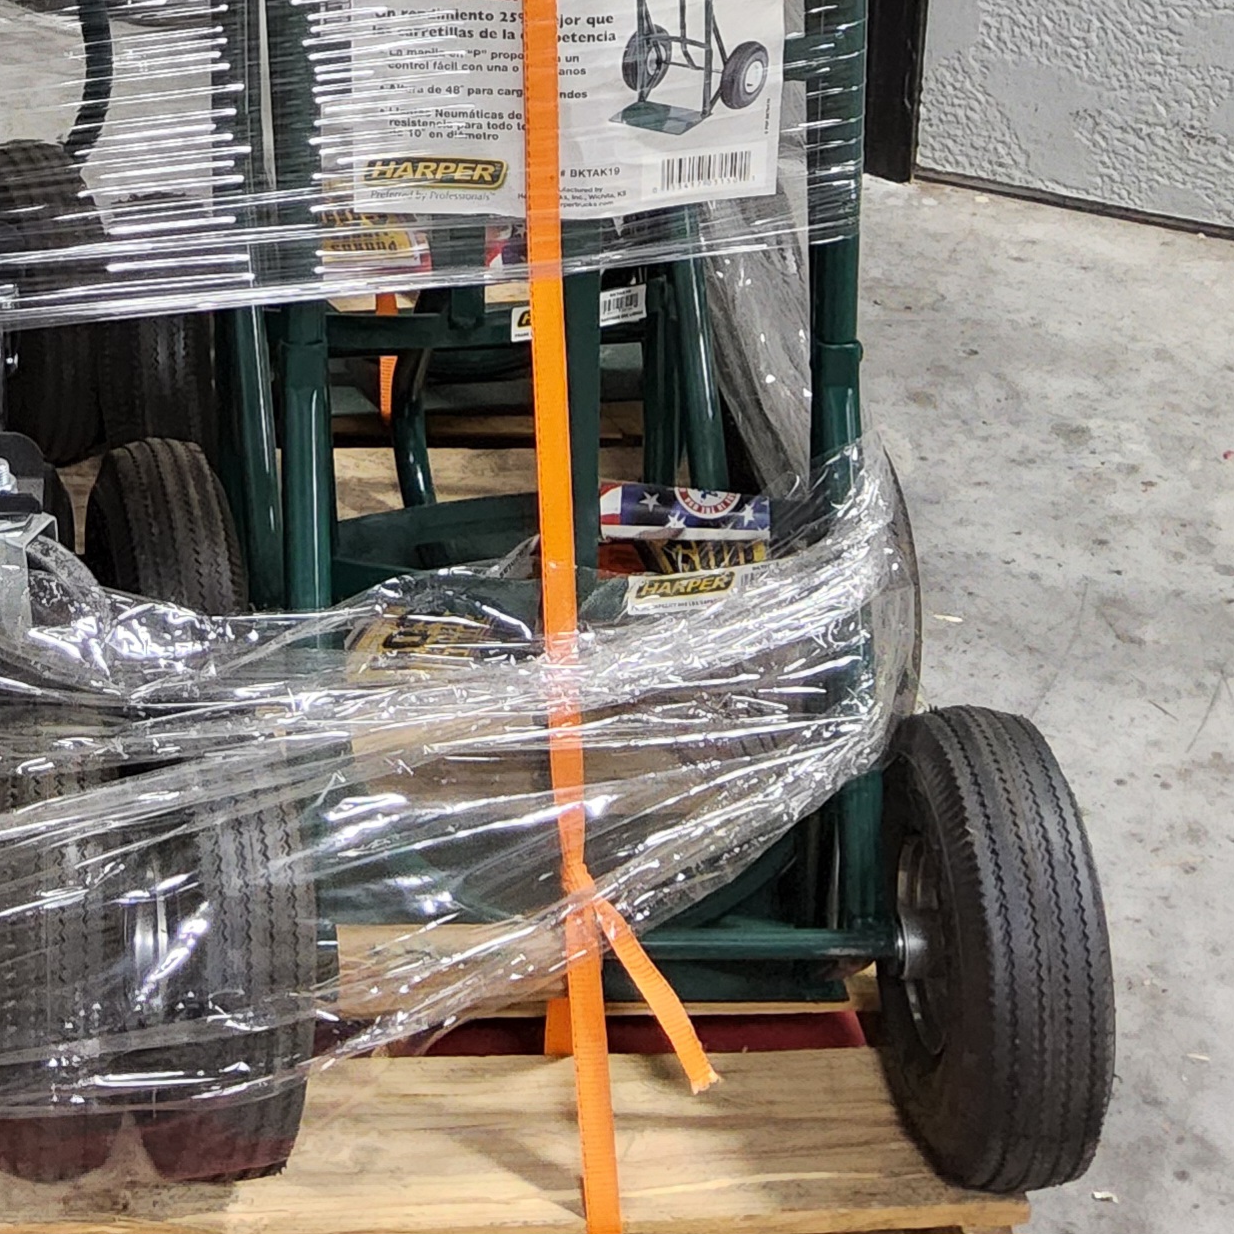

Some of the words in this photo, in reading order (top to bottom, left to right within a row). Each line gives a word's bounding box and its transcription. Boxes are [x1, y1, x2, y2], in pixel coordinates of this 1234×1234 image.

[586, 14, 615, 28] que
[479, 28, 498, 40] de
[502, 29, 516, 40] la
[433, 60, 458, 71] fácil
[462, 63, 483, 72] con
[487, 64, 508, 73] una
[427, 85, 442, 94] de
[467, 87, 494, 97] para
[435, 108, 504, 120] Neumáticas
[508, 112, 522, 121] de
[487, 122, 513, 131] todo
[428, 131, 444, 139] en
[371, 159, 496, 182] HARPER
[569, 166, 621, 178] BKTAK19
[640, 575, 726, 595] HARPER
